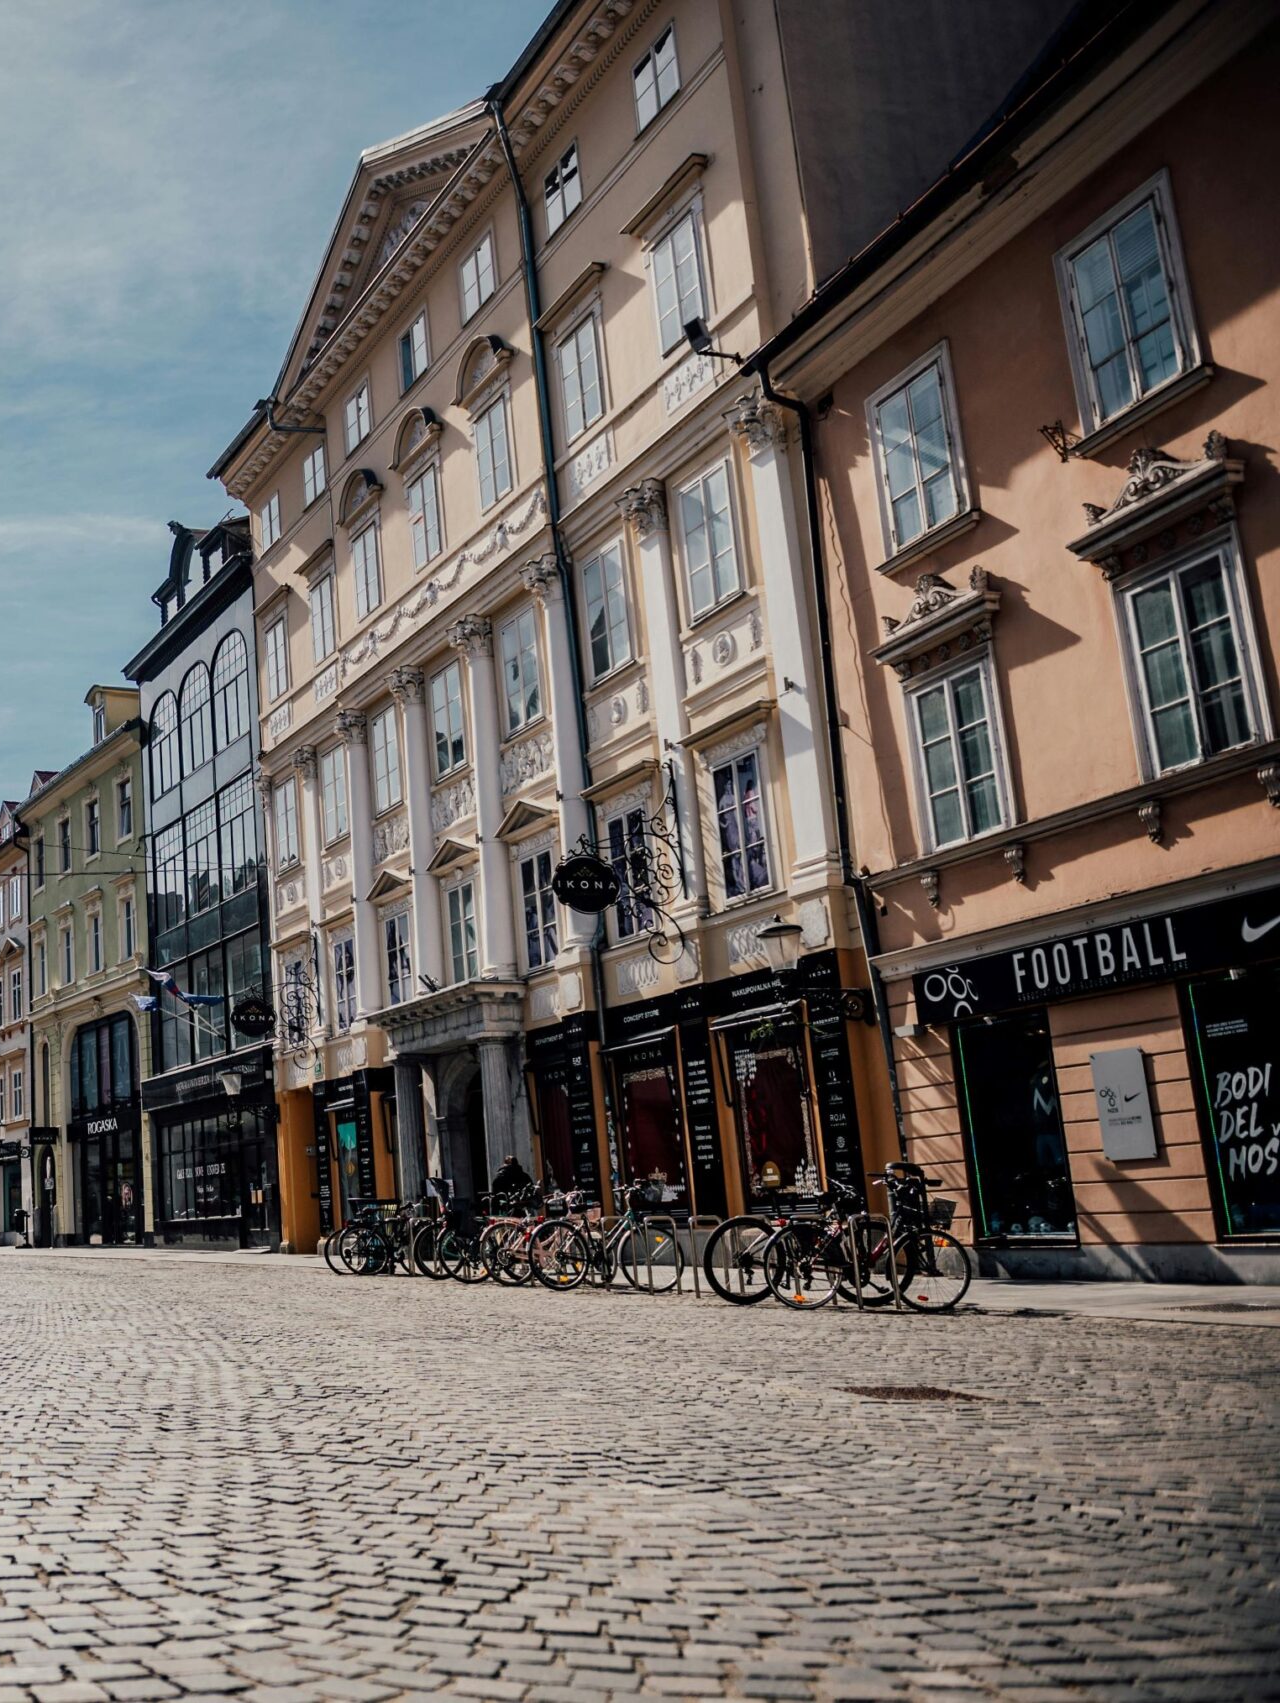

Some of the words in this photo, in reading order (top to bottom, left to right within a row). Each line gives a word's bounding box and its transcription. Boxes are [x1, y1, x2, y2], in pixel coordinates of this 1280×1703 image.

[557, 880, 617, 889] IKONA
[1012, 917, 1187, 994] FOOTBALL
[808, 968, 831, 979] IKONA
[731, 982, 772, 999] NAKUPOVALNA
[771, 979, 782, 989] HIŠ
[680, 1001, 700, 1010] IKONA
[623, 1013, 644, 1024] CONCEPT
[644, 1008, 660, 1019] STORE
[629, 1050, 663, 1063] IKONA
[544, 1070, 566, 1081] IKON
[1214, 1062, 1272, 1109] BODI
[829, 1113, 846, 1122] ROJA
[1219, 1102, 1264, 1143] DEL
